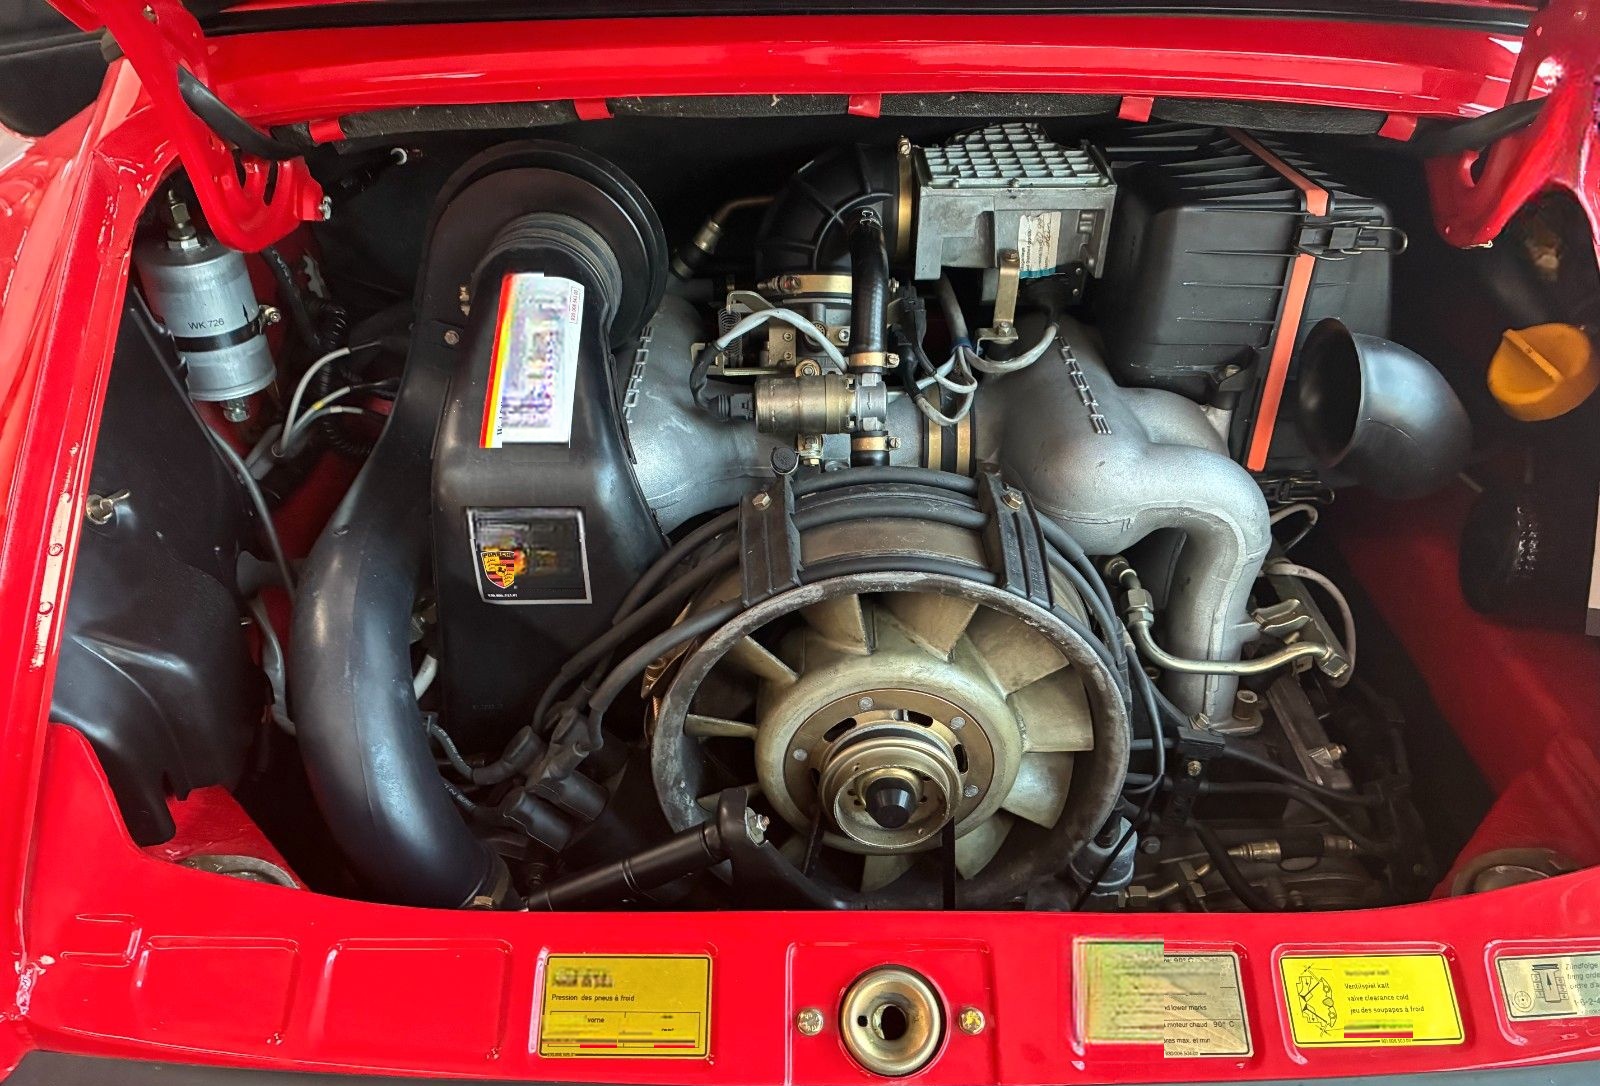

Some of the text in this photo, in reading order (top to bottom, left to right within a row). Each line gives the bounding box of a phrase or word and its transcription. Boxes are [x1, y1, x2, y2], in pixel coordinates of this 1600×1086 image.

[187, 317, 225, 330] WK 726
[620, 994, 635, 1002] froid
[1364, 994, 1395, 1002] clearance
[1350, 1007, 1360, 1015] jeu
[1373, 1006, 1404, 1014] soupapes
[1189, 1020, 1208, 1028] chaud
[1213, 1020, 1226, 1028] 90°
[1228, 1020, 1236, 1028] C
